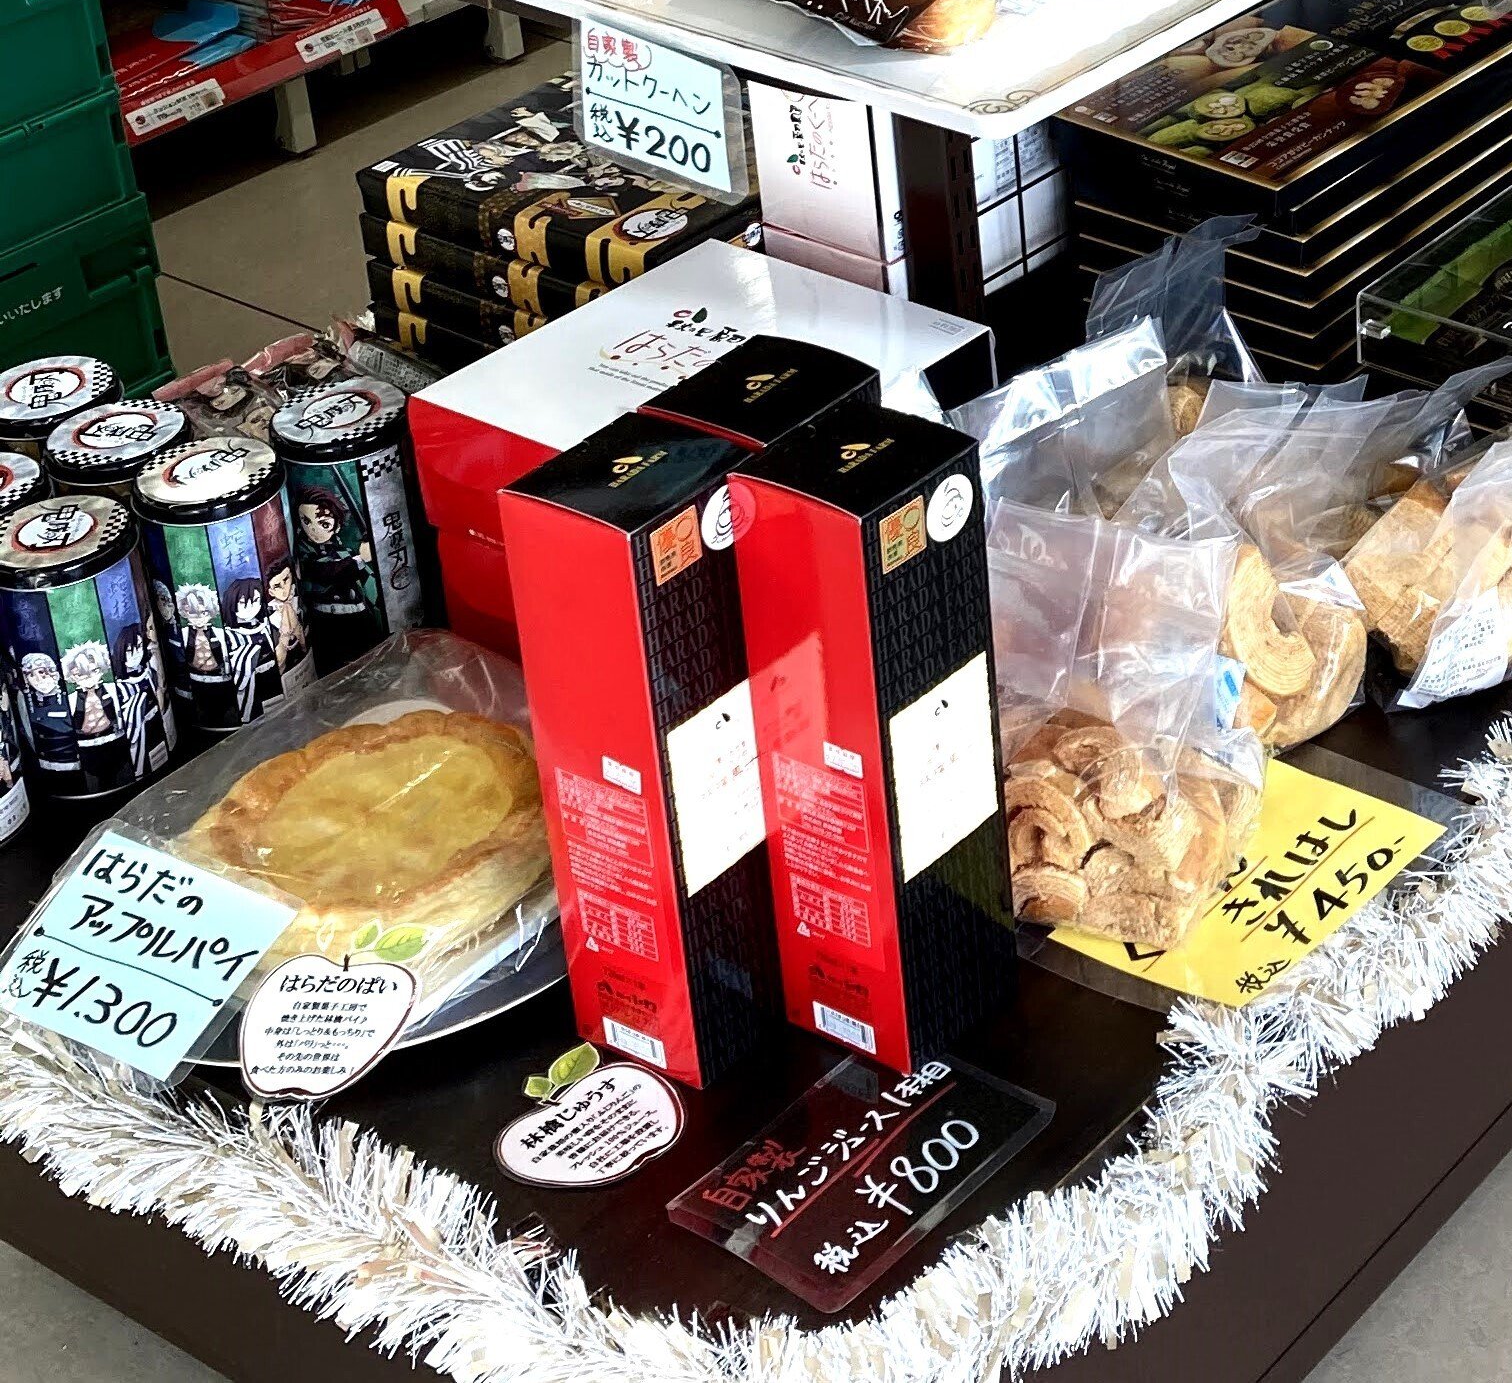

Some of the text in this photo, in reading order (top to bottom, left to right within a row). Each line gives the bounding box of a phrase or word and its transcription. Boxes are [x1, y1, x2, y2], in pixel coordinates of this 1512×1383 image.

[614, 110, 712, 174] ¥200
[82, 847, 204, 916] はらだの
[69, 893, 260, 982] アップルパイ
[279, 974, 398, 994] はらだのぱい
[701, 1138, 809, 1210] 自家製
[814, 1119, 979, 1273] 税込 ¥800
